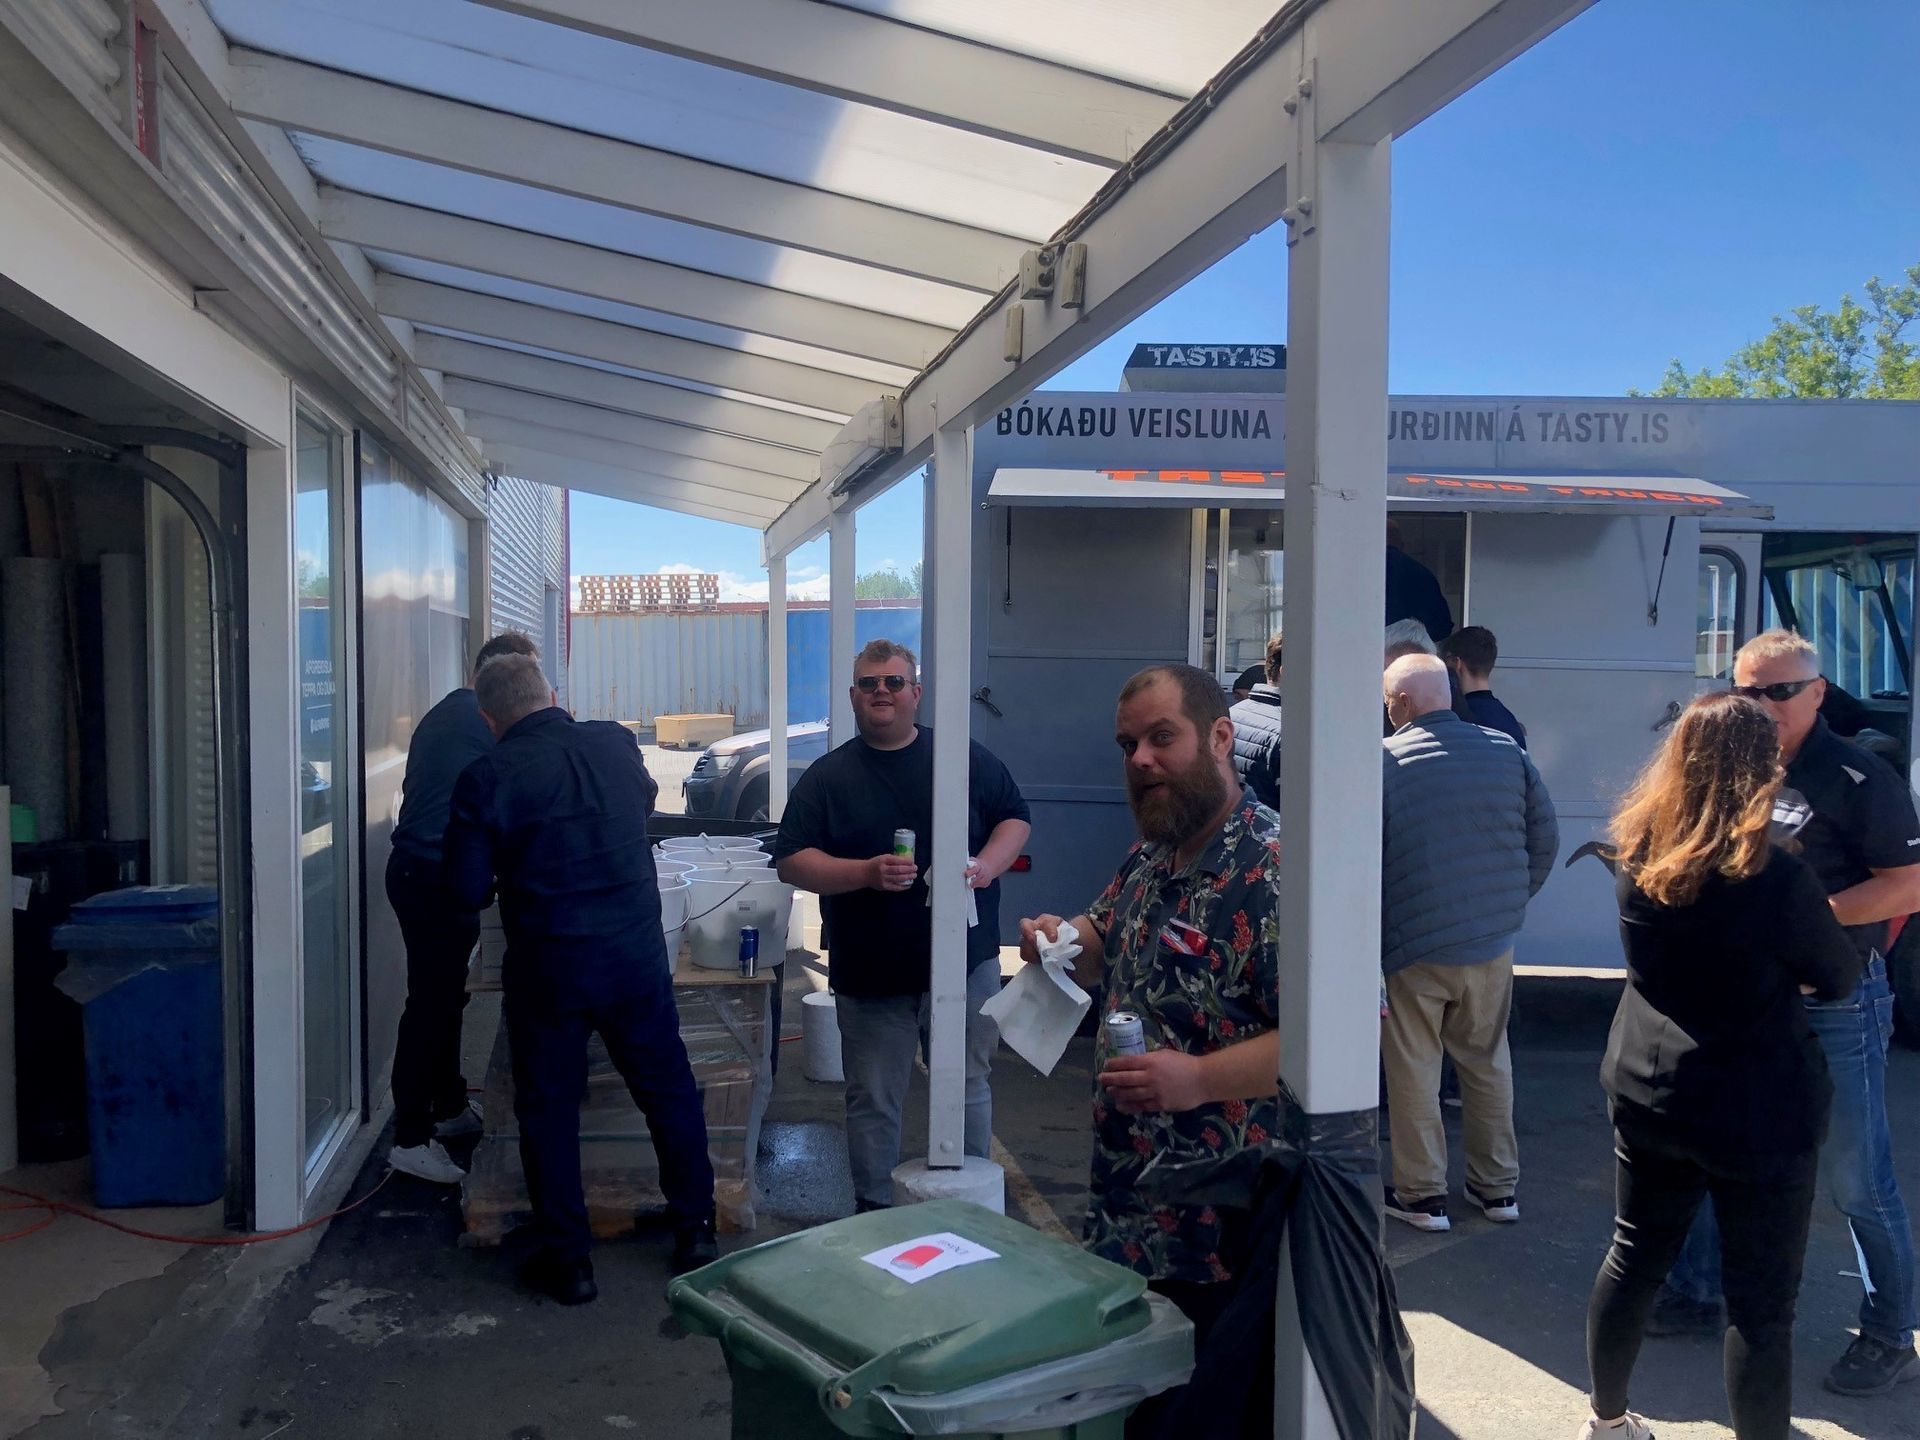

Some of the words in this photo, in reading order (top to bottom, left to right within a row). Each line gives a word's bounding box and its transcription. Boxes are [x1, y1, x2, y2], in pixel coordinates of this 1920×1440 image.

[1147, 346, 1276, 367] TASTY.IS
[996, 400, 1117, 437] BÓKAÐU
[1128, 408, 1271, 440] VEISLUNA
[1387, 410, 1495, 441] URÐINN
[1505, 405, 1526, 442] Á
[1537, 412, 1669, 443] TASTY.IS
[1100, 468, 1285, 484] TAS
[1406, 475, 1530, 491] FOOD
[1546, 486, 1723, 505] TRUCK
